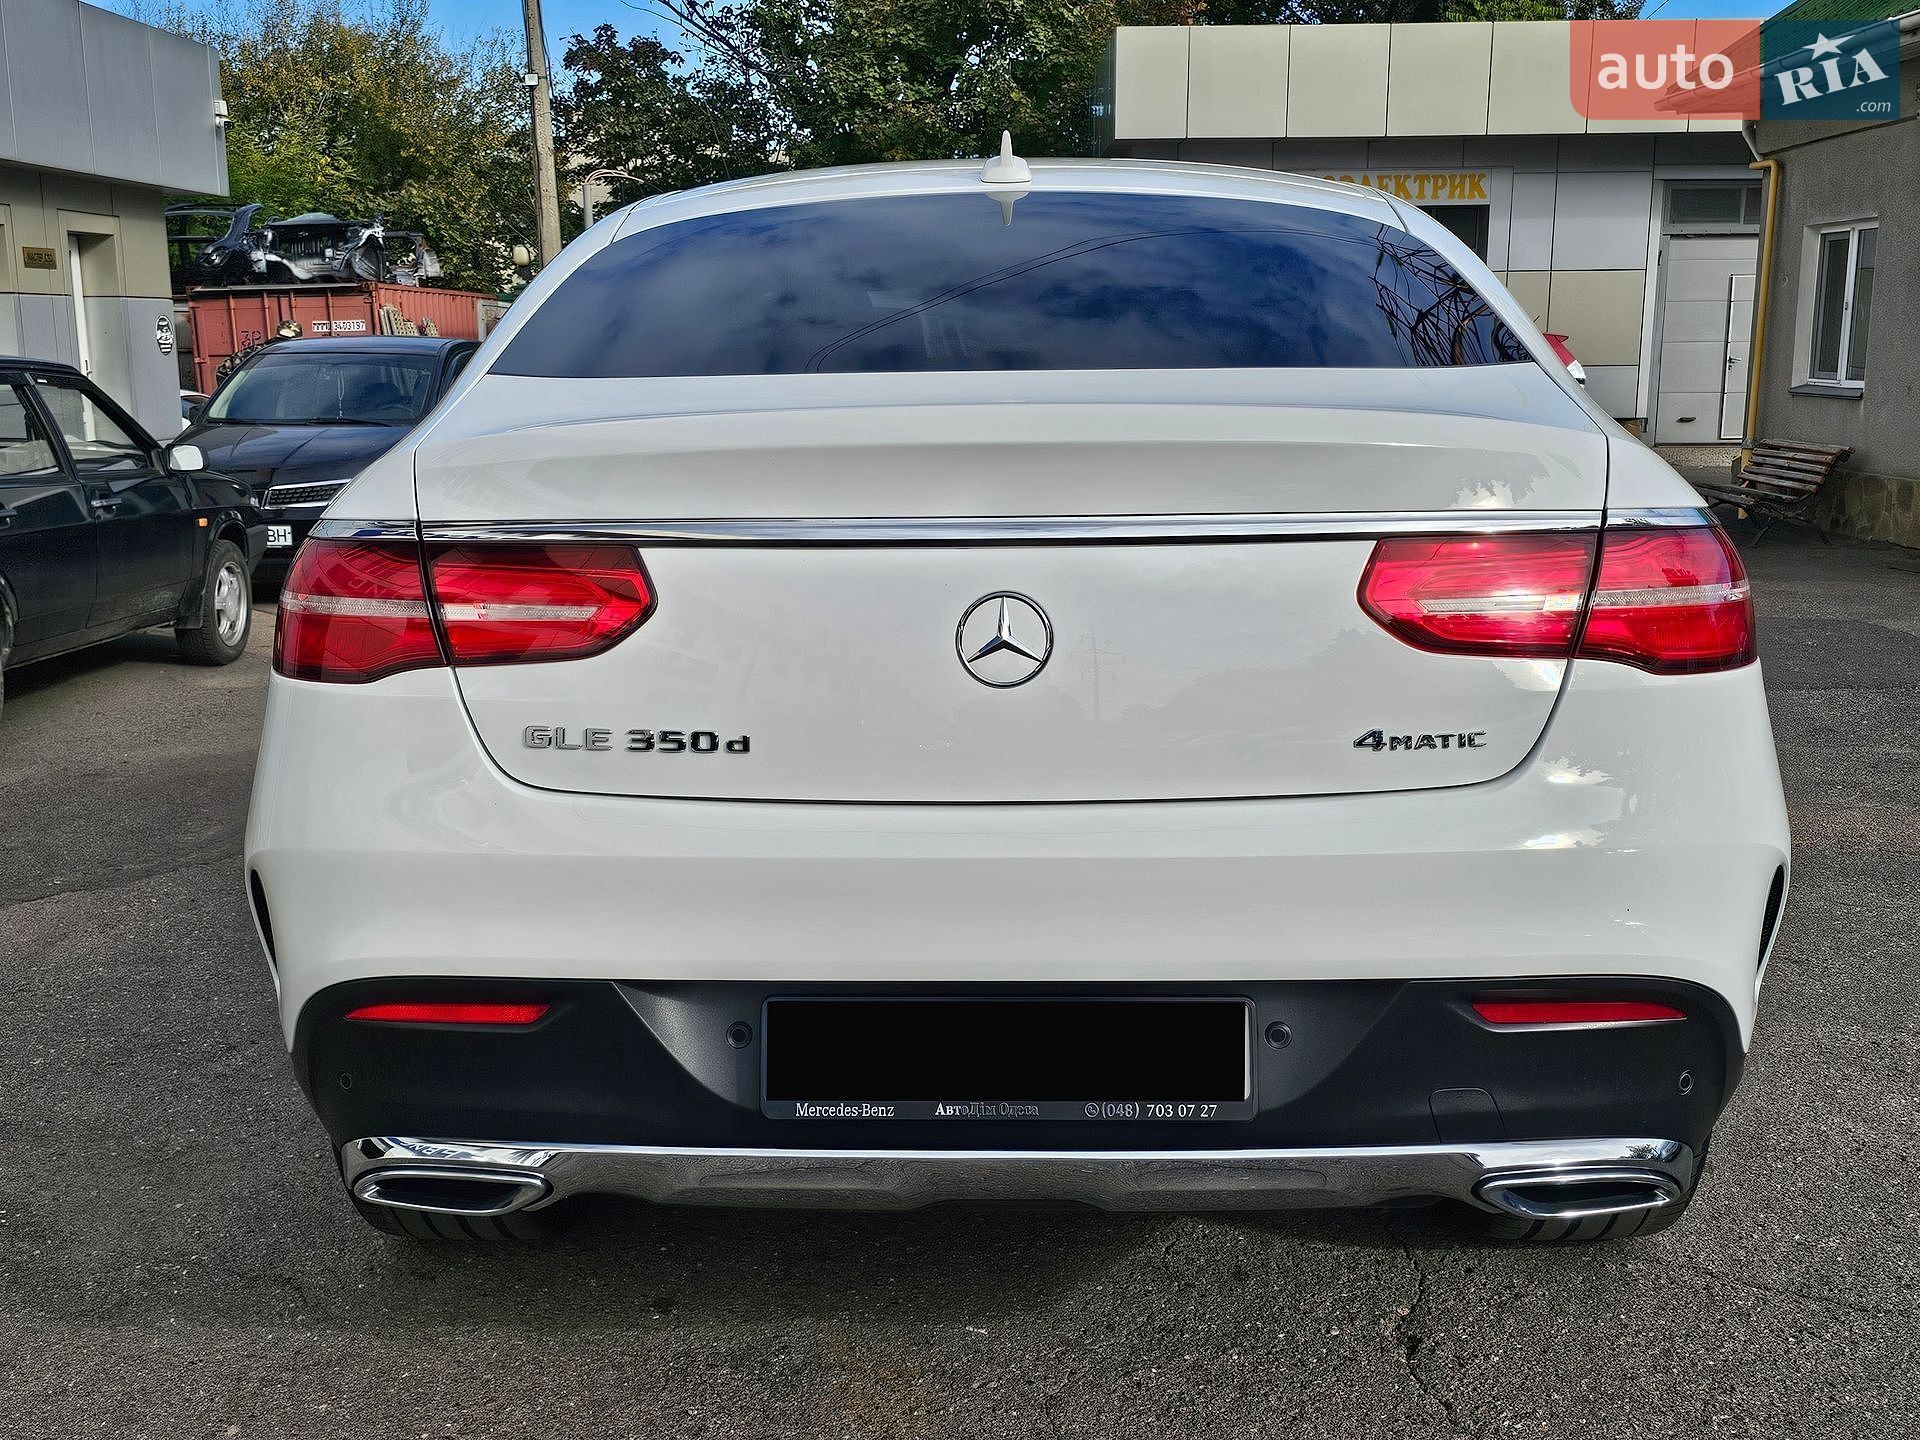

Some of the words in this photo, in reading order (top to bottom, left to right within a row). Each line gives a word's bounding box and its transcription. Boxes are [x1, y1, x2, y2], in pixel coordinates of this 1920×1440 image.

[523, 725, 613, 750] GLE
[1353, 728, 1487, 751] 4MATIC
[795, 1103, 895, 1117] Mercedes-Benz
[1101, 1102, 1140, 1118] (048)
[1146, 1104, 1173, 1117] 703
[1178, 1104, 1196, 1117] 07
[1200, 1104, 1217, 1117] 27
